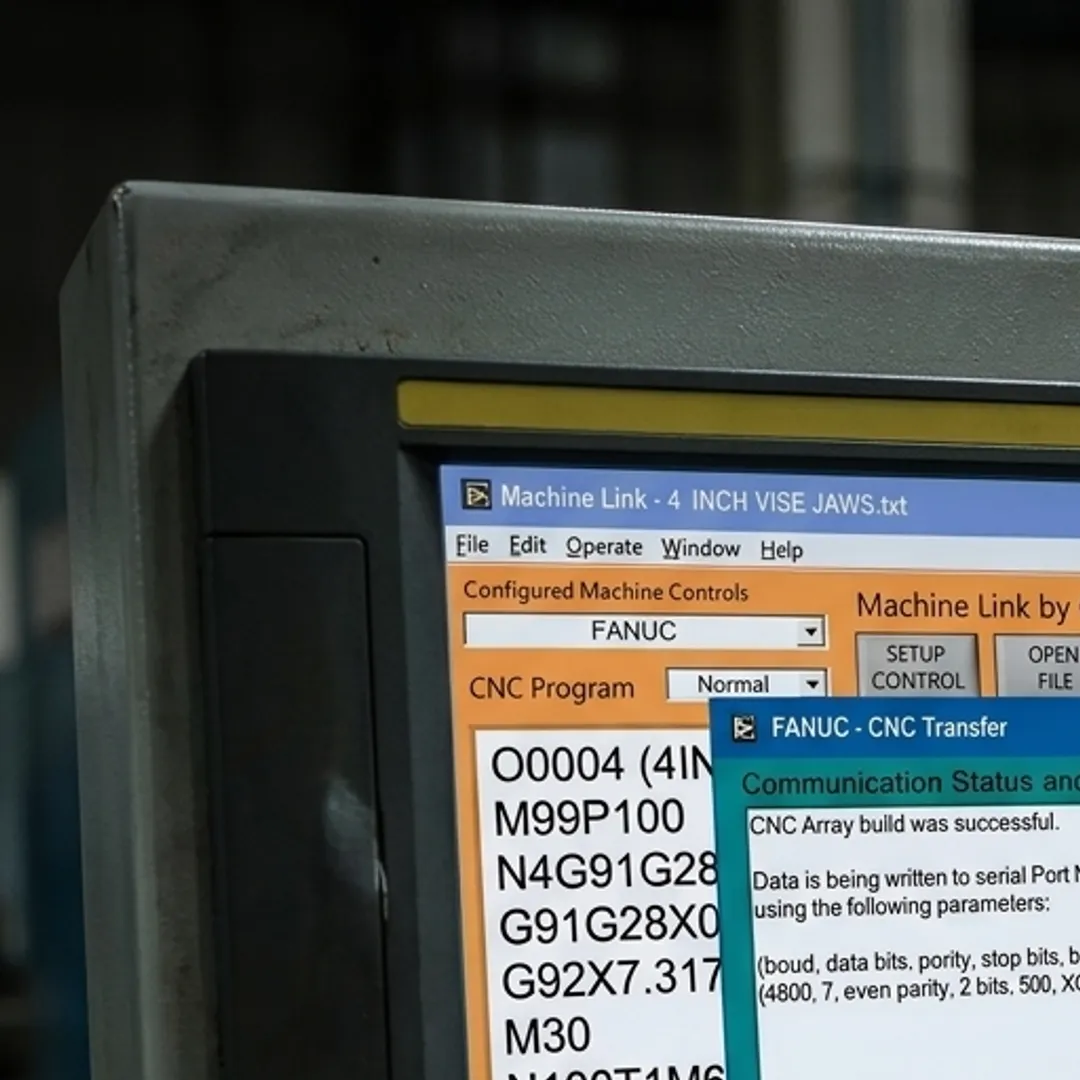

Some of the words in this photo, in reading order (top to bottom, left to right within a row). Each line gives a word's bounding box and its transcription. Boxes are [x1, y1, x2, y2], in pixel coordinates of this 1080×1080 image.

[501, 484, 594, 508] Machine
[600, 487, 648, 511] Link
[667, 490, 680, 510] 4
[692, 489, 748, 512] INCH
[754, 491, 806, 513] VISE
[811, 493, 908, 516] JAWS.txt
[456, 534, 489, 556] File
[510, 535, 547, 556] Edit
[566, 536, 643, 559] Operate
[661, 538, 741, 559] Window
[761, 540, 804, 562] Help
[464, 580, 574, 604] Configured
[580, 582, 662, 600] Machine
[668, 583, 749, 602] Controls
[857, 592, 969, 618] Machine
[979, 594, 1030, 619] Link
[1040, 593, 1070, 626] by
[591, 620, 677, 641] FANUC
[887, 645, 945, 663] SETUP
[1028, 646, 1079, 664] OPEN
[469, 677, 523, 700] CNC
[530, 677, 635, 705] Program
[698, 675, 770, 694] Normal
[872, 671, 966, 690] CONTROL
[1038, 673, 1073, 690] FILE
[771, 717, 849, 738] FANUC
[868, 716, 916, 738] CNC
[922, 716, 1008, 738] Transfer
[640, 744, 713, 788] (4IN
[742, 771, 942, 796] Communication
[952, 770, 1033, 794] Status
[494, 799, 684, 836] M99P100
[750, 815, 797, 834] CNC
[802, 814, 854, 838] Array
[860, 814, 905, 834] build
[910, 817, 948, 832] was
[954, 812, 1060, 832] successful.
[497, 851, 718, 890] N4G91G28
[753, 871, 799, 890] Data
[805, 870, 821, 889] is
[826, 870, 880, 893] being
[884, 867, 947, 887] written
[952, 867, 969, 886] to
[976, 866, 1026, 885] serial
[1031, 864, 1070, 883] Port
[755, 899, 807, 922] using
[812, 898, 842, 916] the
[847, 896, 931, 919] following
[937, 894, 1050, 919] parameters:
[500, 904, 720, 945] G91G28X0
[826, 953, 869, 972] data
[981, 949, 1022, 971] stop
[502, 958, 721, 1000] G92X7.317
[843, 984, 891, 1001] even
[959, 976, 971, 997] 2
[505, 1016, 591, 1055] M30
